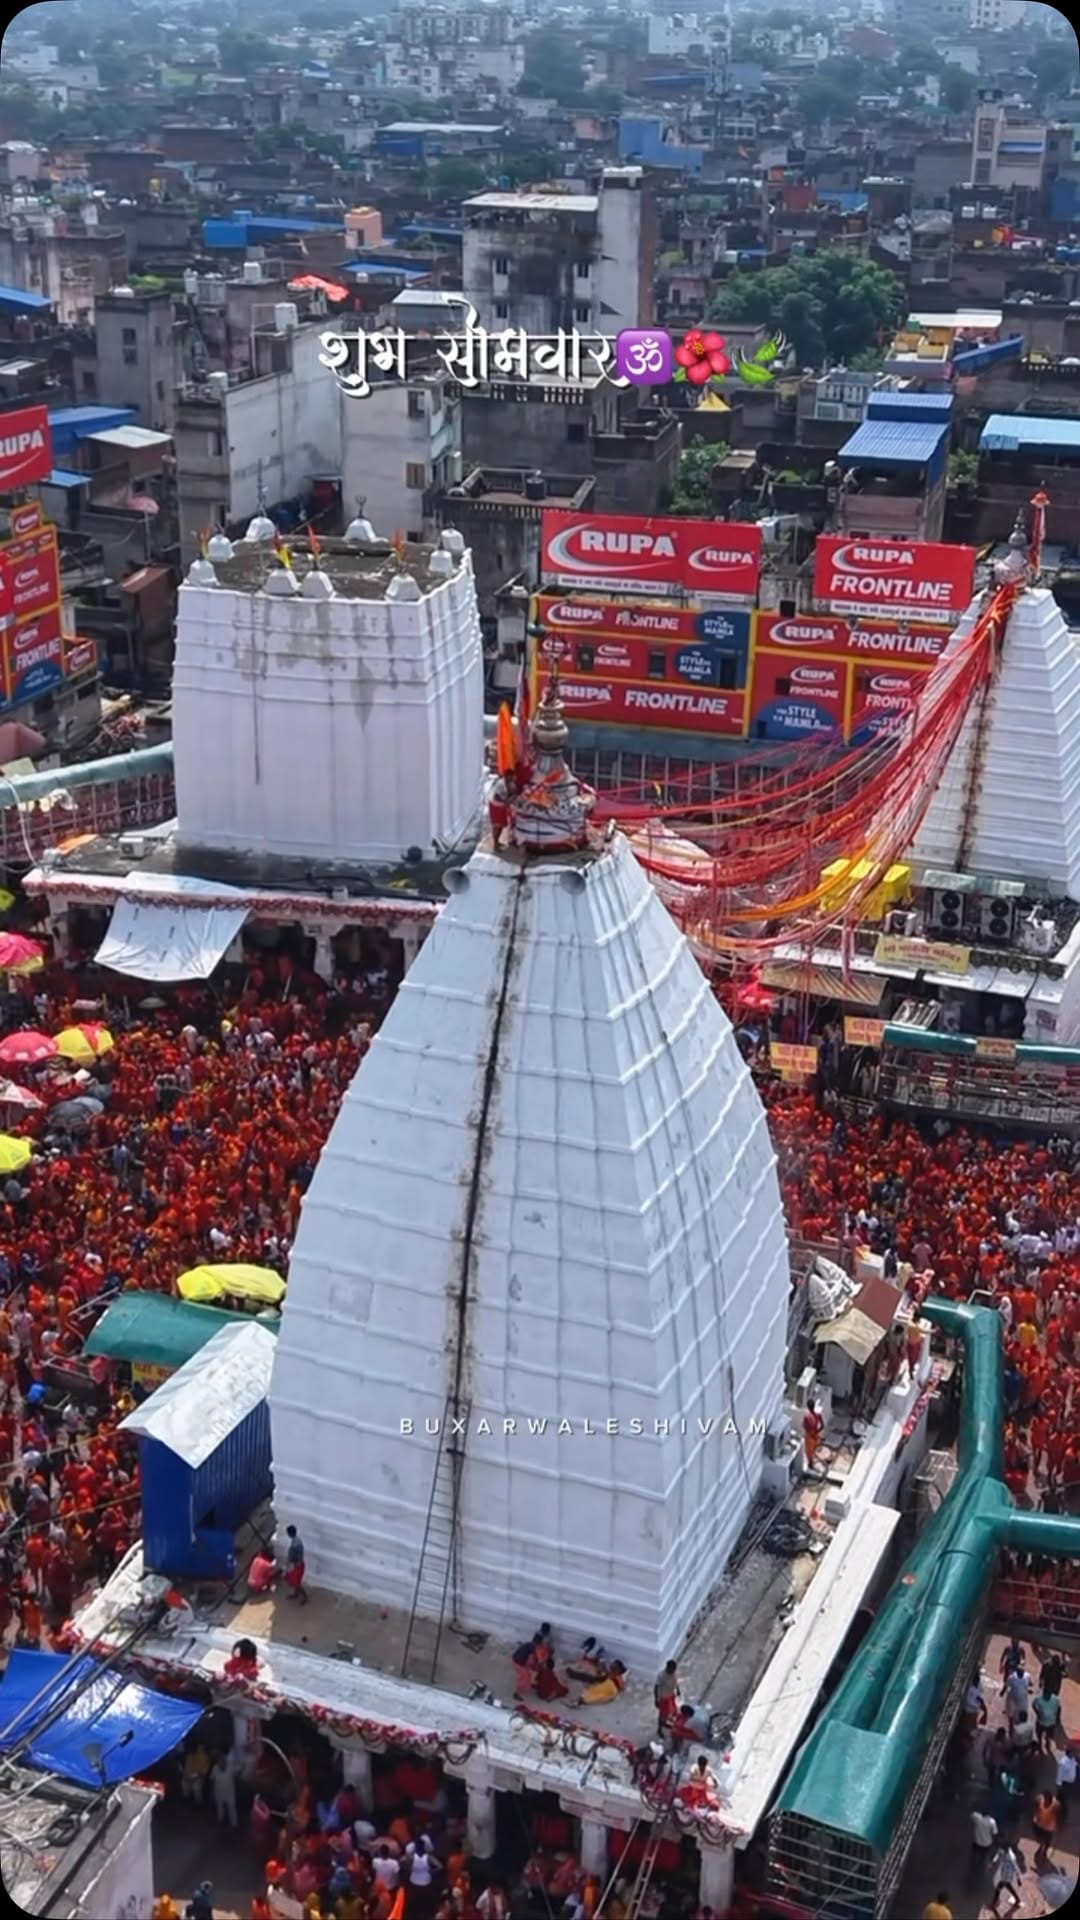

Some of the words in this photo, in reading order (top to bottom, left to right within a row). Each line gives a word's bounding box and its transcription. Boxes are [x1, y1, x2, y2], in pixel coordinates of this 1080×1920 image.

[580, 530, 676, 557] RUPA
[705, 550, 753, 564] RUPA
[853, 547, 914, 565] RUPA
[830, 574, 953, 601] FRONTLINE
[560, 606, 604, 620] RUPA
[785, 625, 835, 640] RUPA
[848, 631, 943, 654] FRONTLINE
[559, 684, 612, 701] RUPA
[624, 689, 729, 715] FRONTLINE
[788, 705, 816, 719] STYLE
